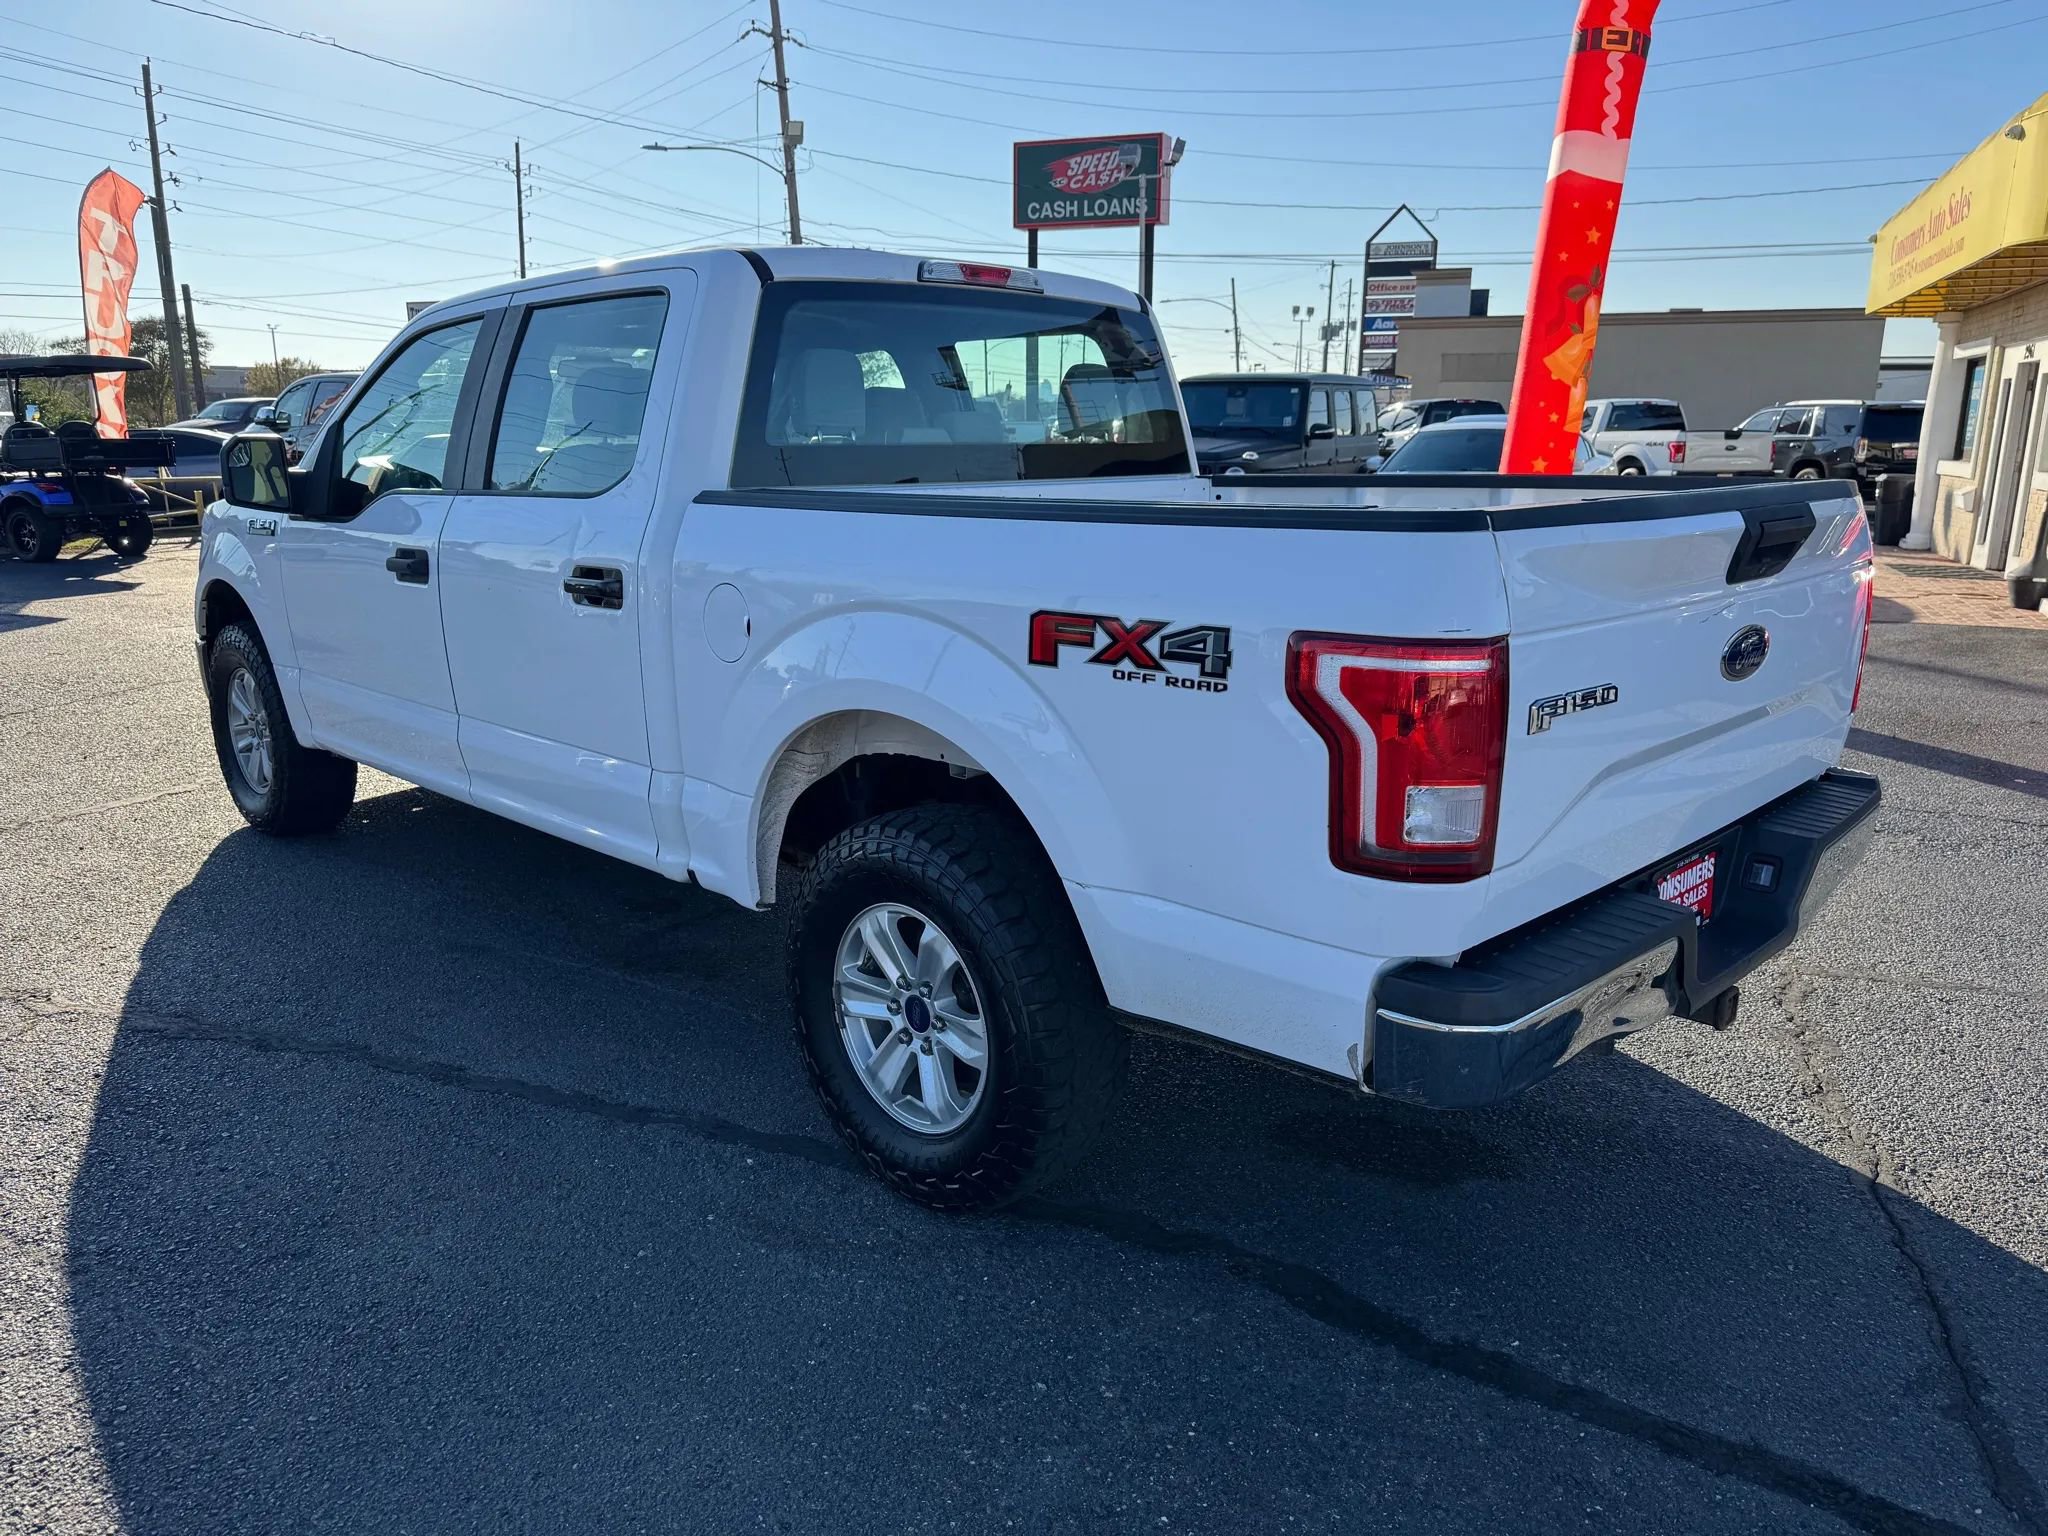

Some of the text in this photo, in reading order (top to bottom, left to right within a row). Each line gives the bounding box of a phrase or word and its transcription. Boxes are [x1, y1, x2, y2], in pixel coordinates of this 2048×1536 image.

[1066, 150, 1120, 177] SPEED
[1027, 197, 1148, 219] CASH LOANS
[1926, 207, 1946, 244] Auto
[1946, 185, 1973, 231] Sales
[1369, 282, 1398, 292] Office
[1372, 318, 1399, 330] Aar
[1028, 610, 1232, 681] FX4
[1112, 669, 1229, 693] OFF ROAD
[1657, 857, 1715, 901] ONSUMERS
[1682, 882, 1709, 907] SALES
